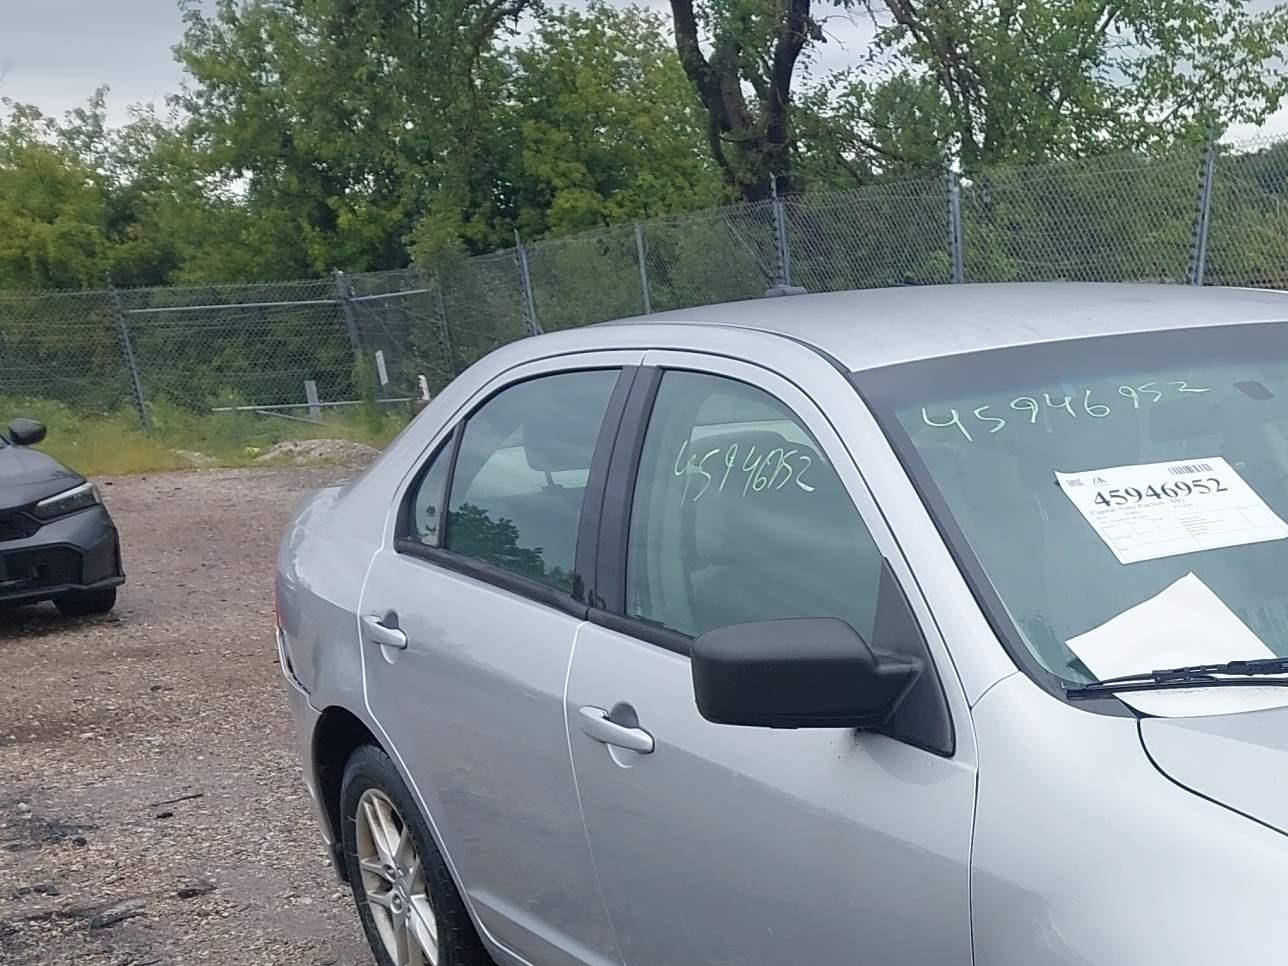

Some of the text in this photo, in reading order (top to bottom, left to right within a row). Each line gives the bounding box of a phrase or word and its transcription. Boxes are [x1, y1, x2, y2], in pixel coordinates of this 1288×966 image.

[921, 381, 1213, 442] 45946952
[673, 439, 816, 506] 45946952
[1094, 477, 1228, 507] 45946952
